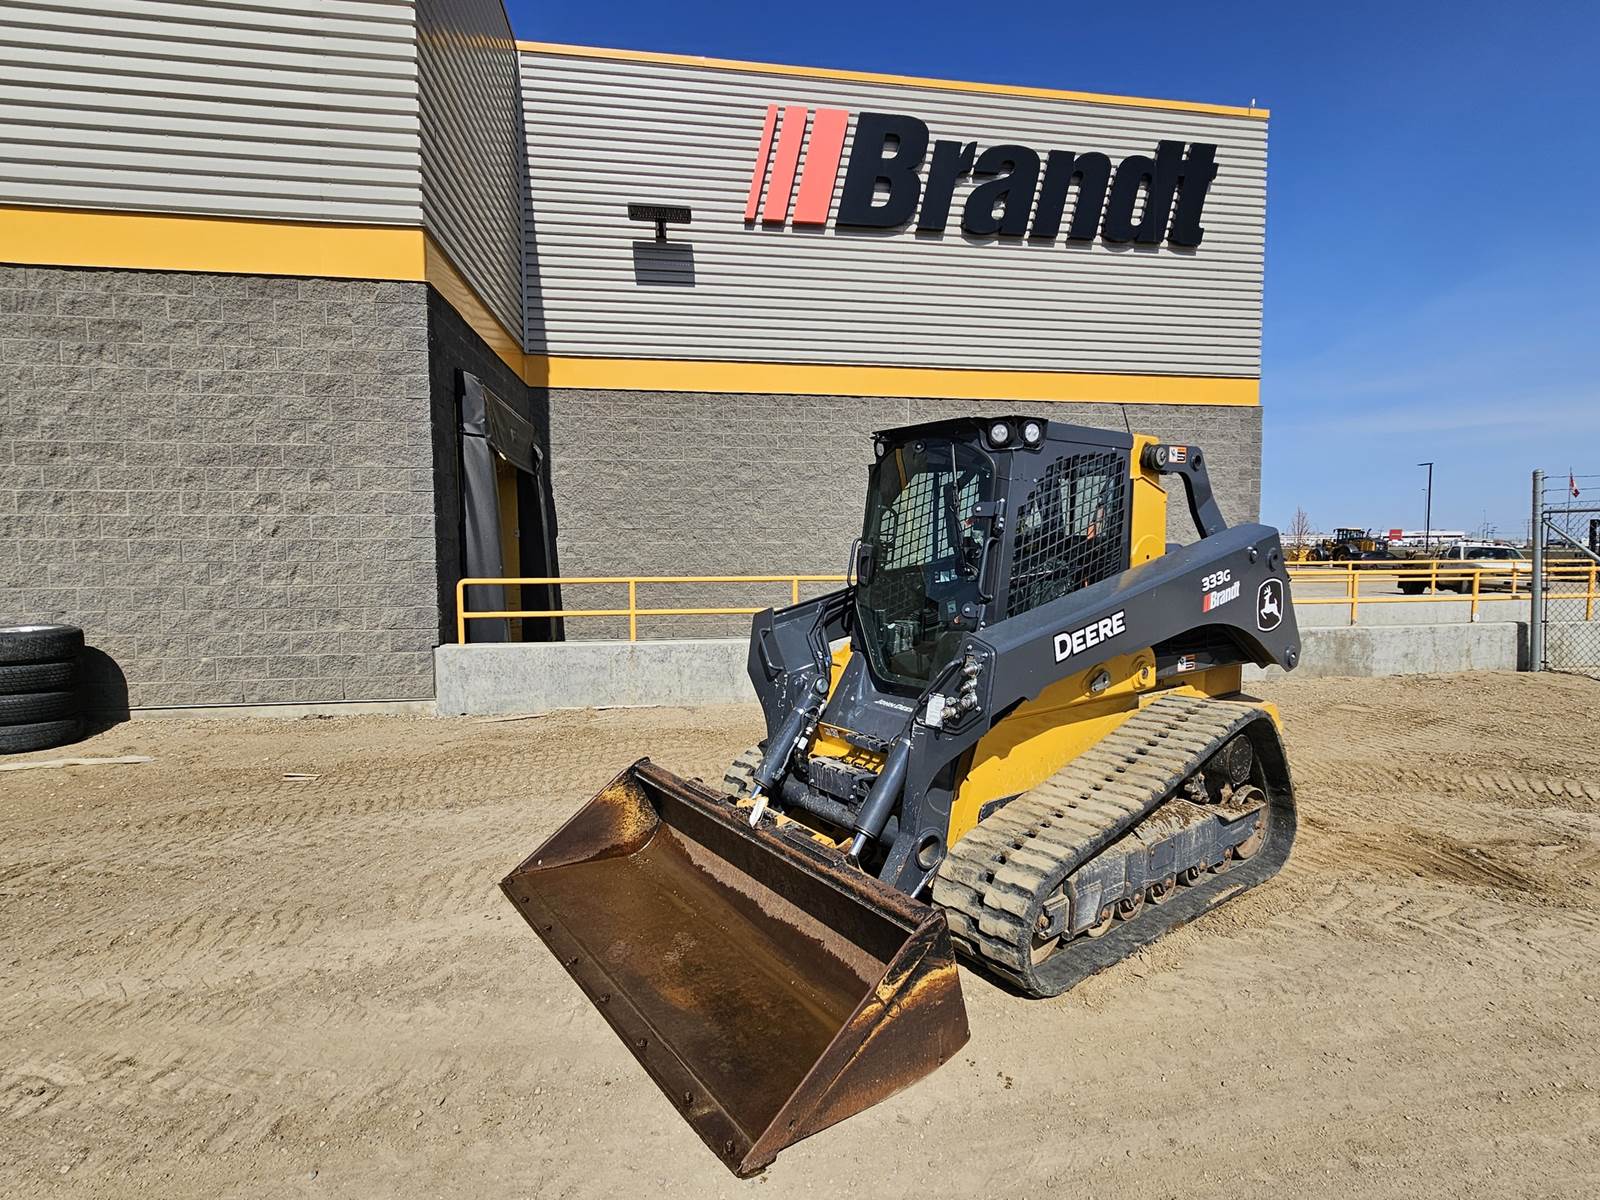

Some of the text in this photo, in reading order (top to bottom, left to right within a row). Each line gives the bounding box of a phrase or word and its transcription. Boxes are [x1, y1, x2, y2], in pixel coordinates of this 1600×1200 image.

[836, 112, 1218, 247] Brandt
[1202, 569, 1231, 592] 333G
[1210, 580, 1241, 609] Brandt
[1053, 610, 1126, 663] DEERE
